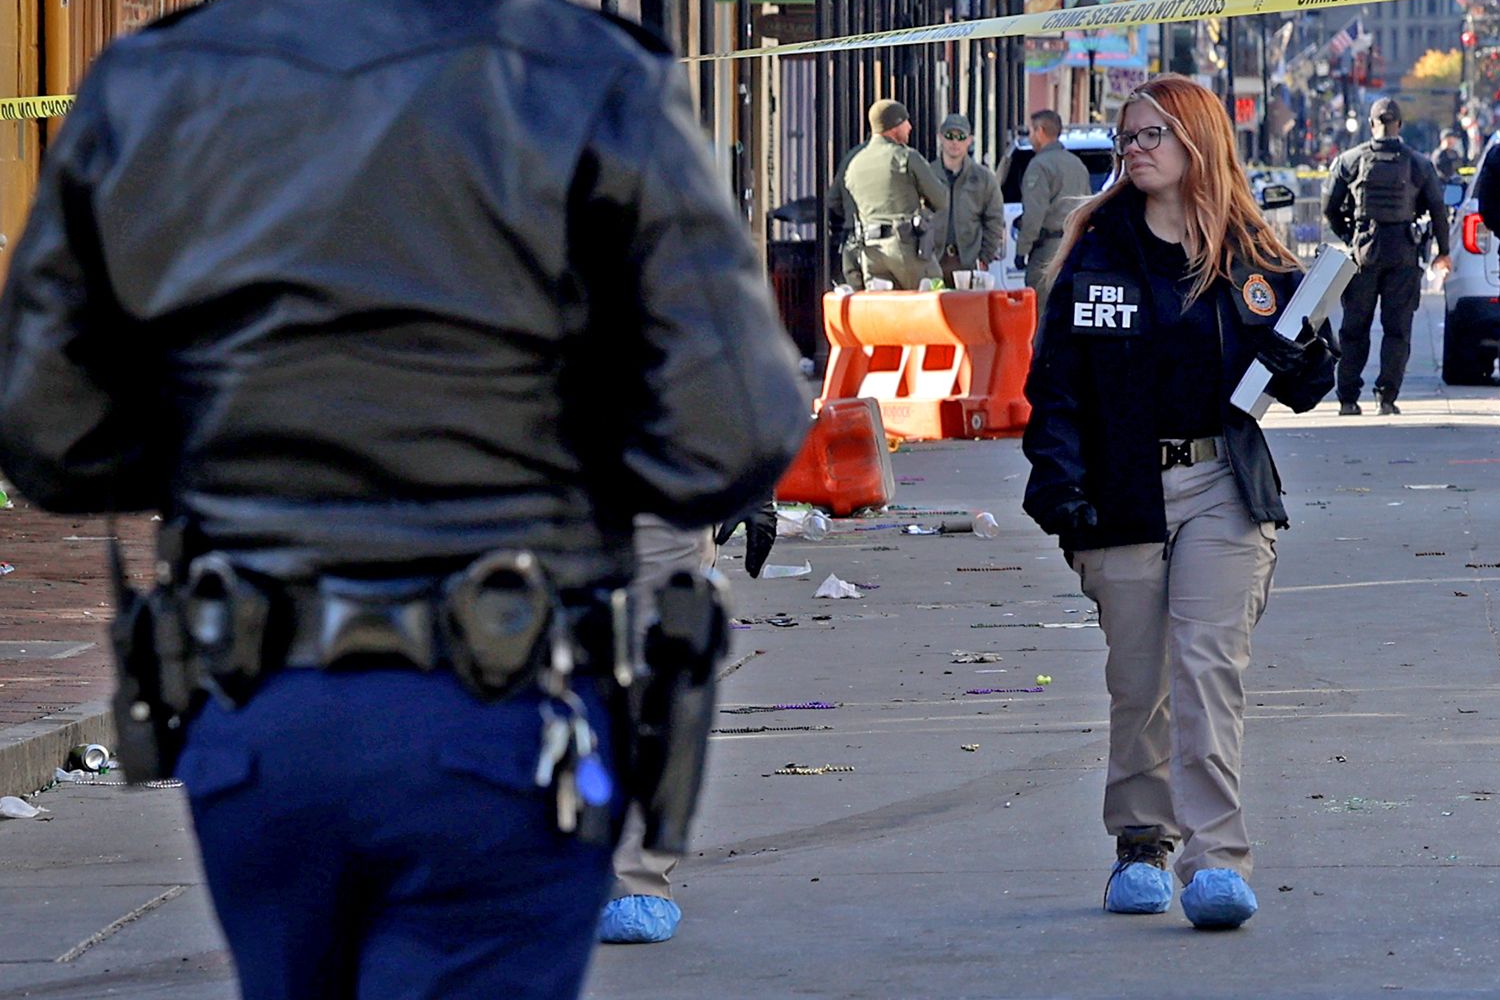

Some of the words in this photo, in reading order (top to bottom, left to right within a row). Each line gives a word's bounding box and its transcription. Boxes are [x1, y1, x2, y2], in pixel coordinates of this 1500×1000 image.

[1042, 11, 1091, 30] CRIME
[1086, 5, 1133, 25] SCENE
[1130, 1, 1152, 23] DO
[1151, 0, 1186, 20] NOT
[1089, 284, 1124, 303] FBI
[1073, 301, 1138, 329] ERT
